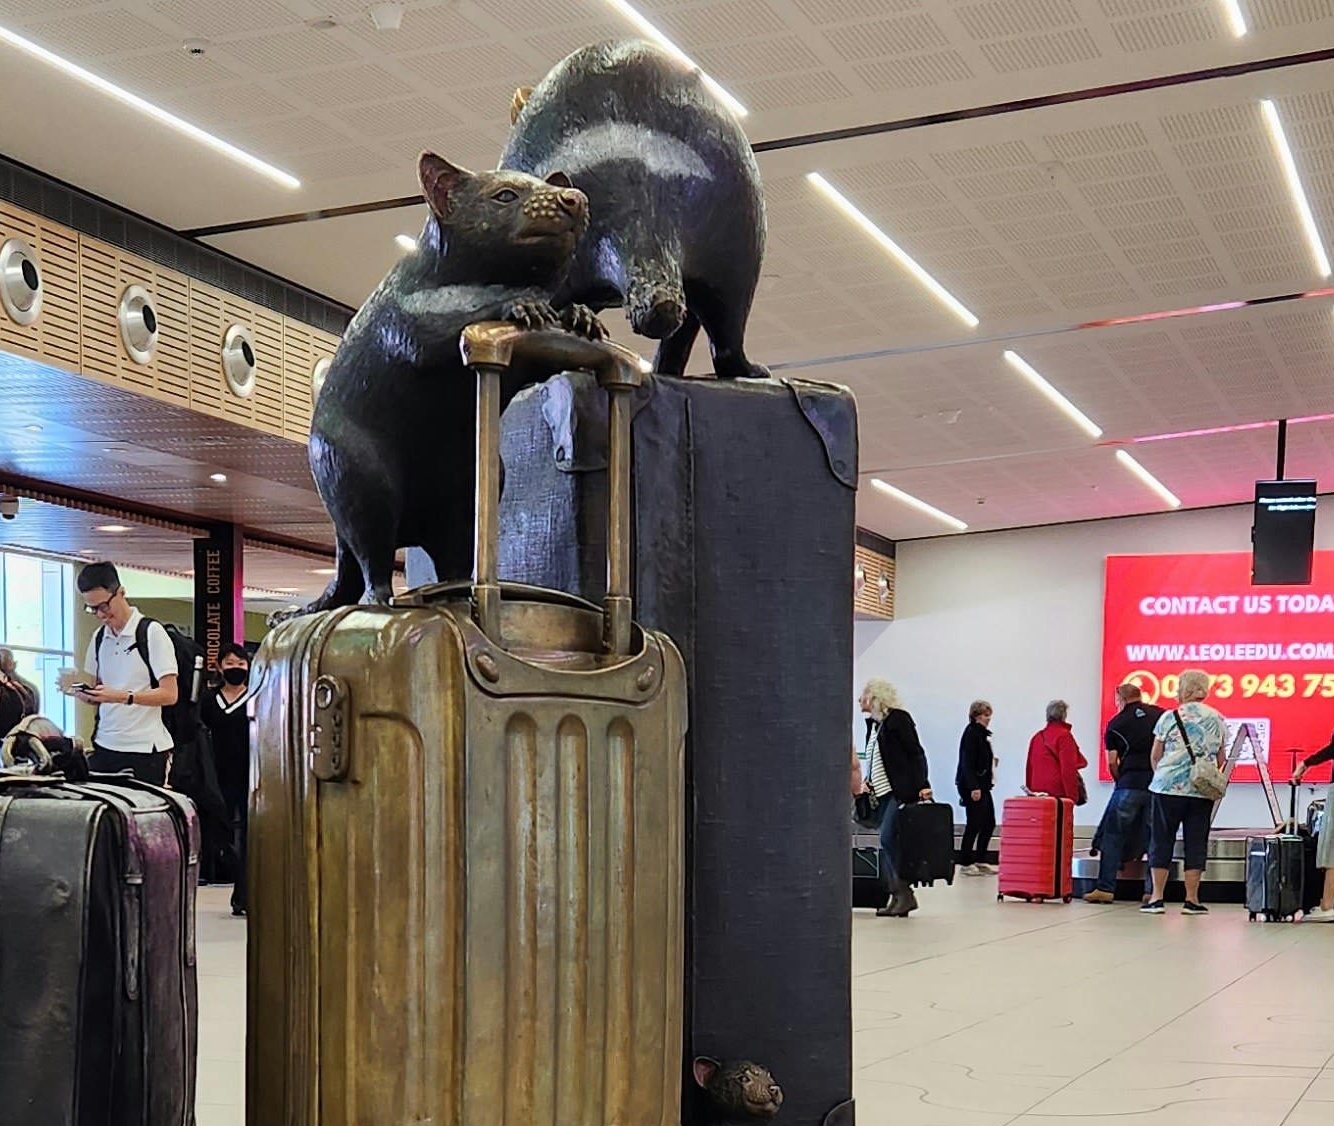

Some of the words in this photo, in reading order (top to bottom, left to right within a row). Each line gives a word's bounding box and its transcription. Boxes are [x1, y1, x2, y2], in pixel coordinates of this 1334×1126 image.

[207, 549, 220, 594] COFFEE
[1139, 596, 1239, 615] CONTACT
[1243, 595, 1271, 614] US
[1241, 674, 1295, 698] 943
